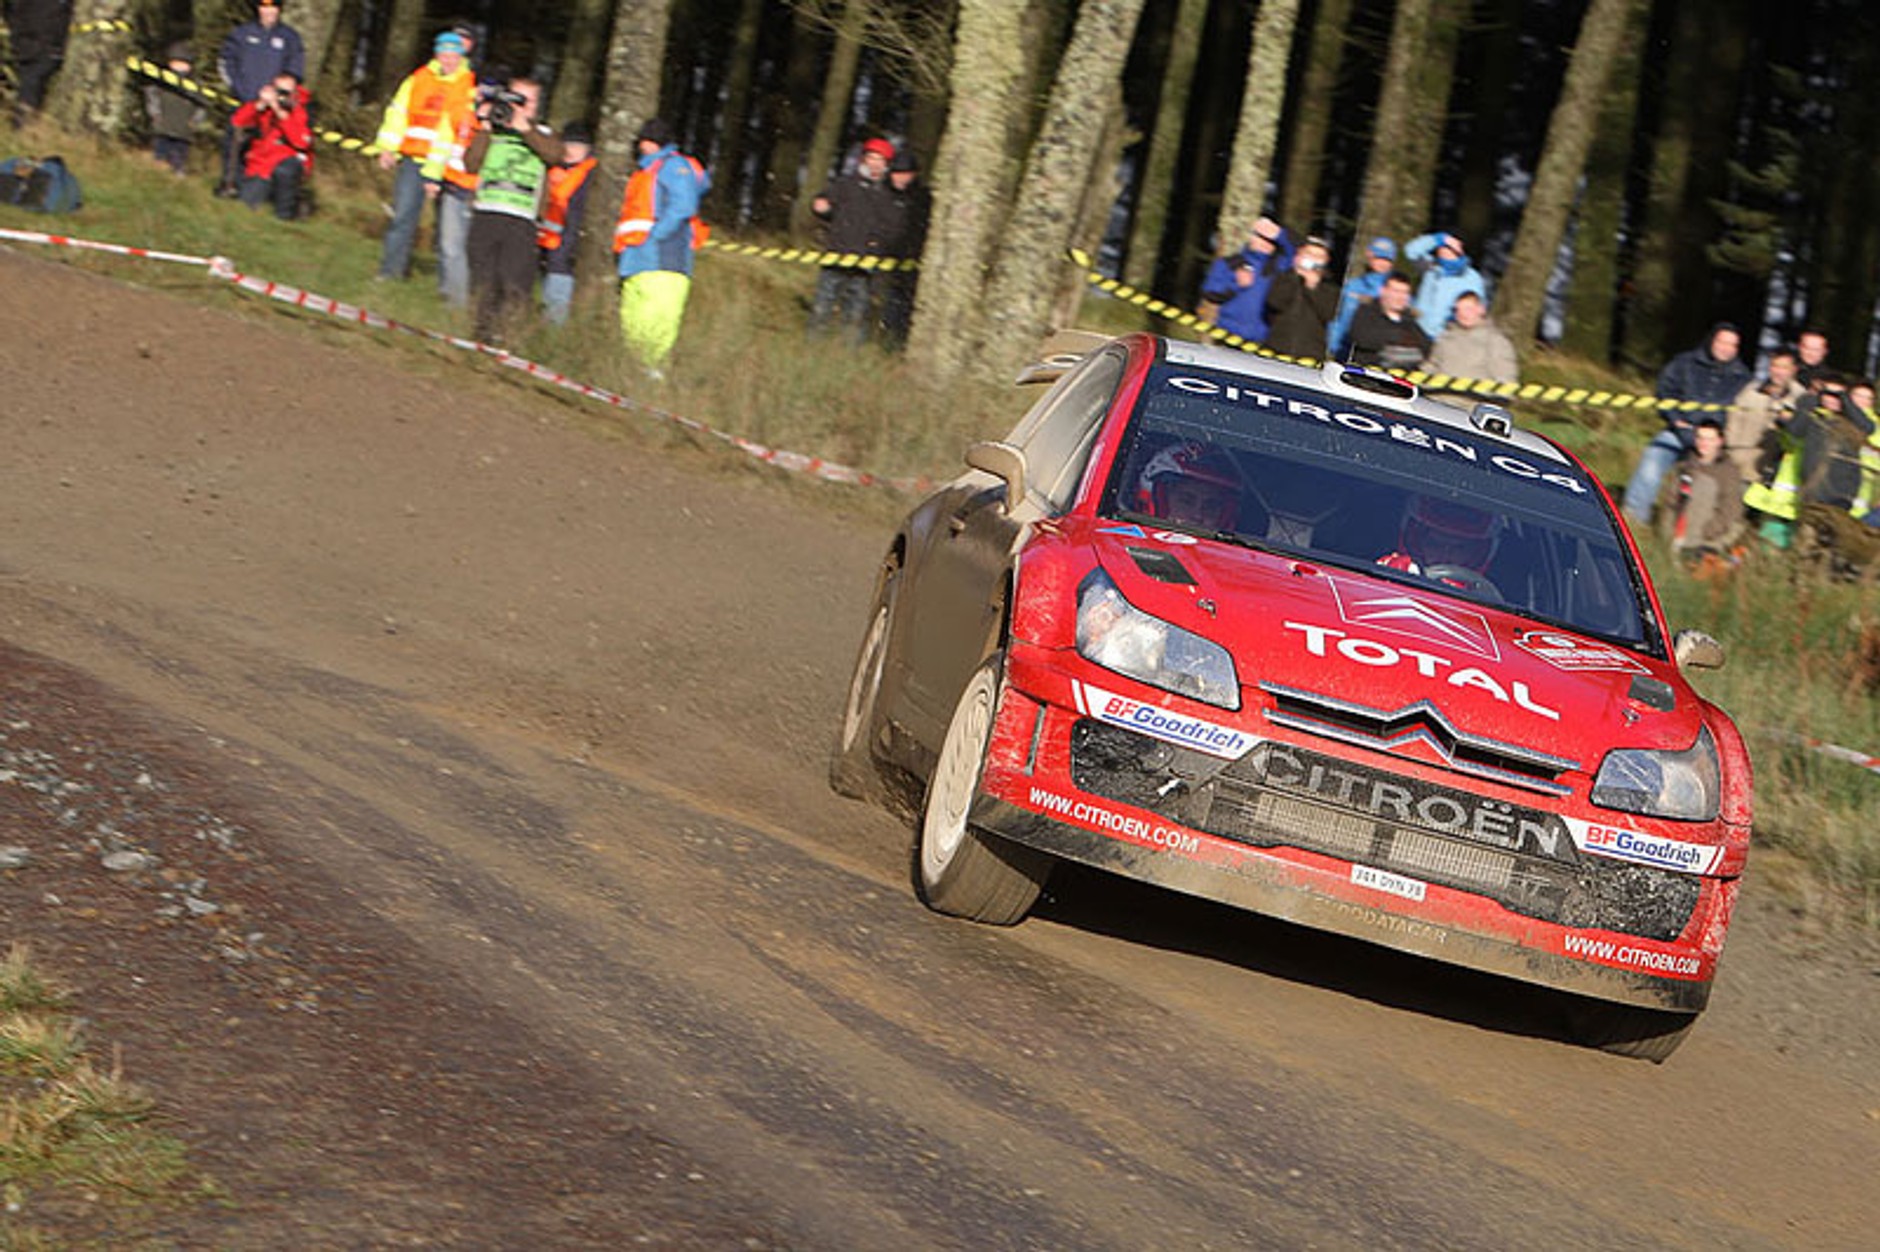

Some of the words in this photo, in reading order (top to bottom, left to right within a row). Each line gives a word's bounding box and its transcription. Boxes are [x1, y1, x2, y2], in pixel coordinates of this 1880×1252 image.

[1166, 377, 1477, 462] CITROËN
[1491, 455, 1588, 494] C4
[1283, 620, 1561, 721] TOTAL
[1103, 697, 1245, 750] BFGoodrich
[1028, 786, 1200, 853] WWW.CITROEN.COM
[1252, 749, 1560, 858] CITROËN
[1585, 825, 1702, 865] BFGoodrich
[1563, 934, 1701, 975] WWW.CITROEN.COM
